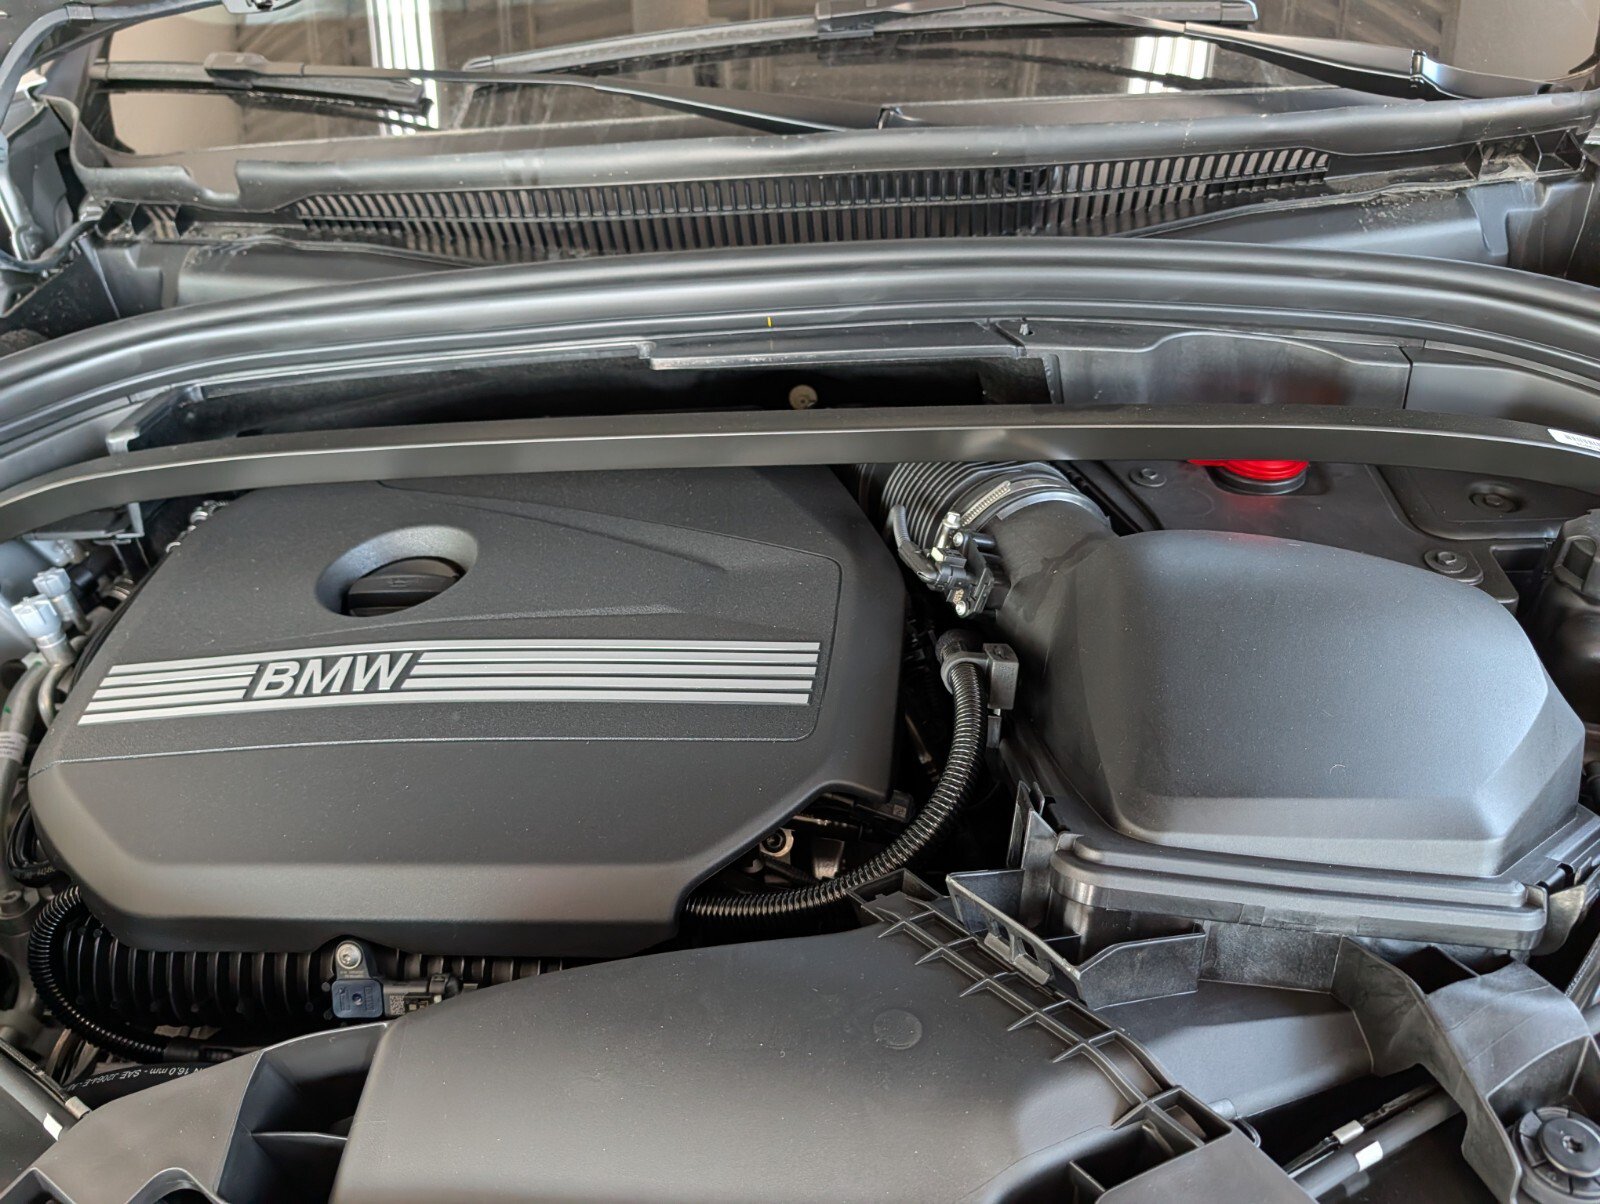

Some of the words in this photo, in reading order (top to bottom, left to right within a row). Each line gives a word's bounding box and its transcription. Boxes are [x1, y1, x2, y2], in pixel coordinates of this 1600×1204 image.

[252, 652, 413, 699] BMW
[119, 1069, 142, 1079] SAE
[149, 1067, 169, 1075] mm
